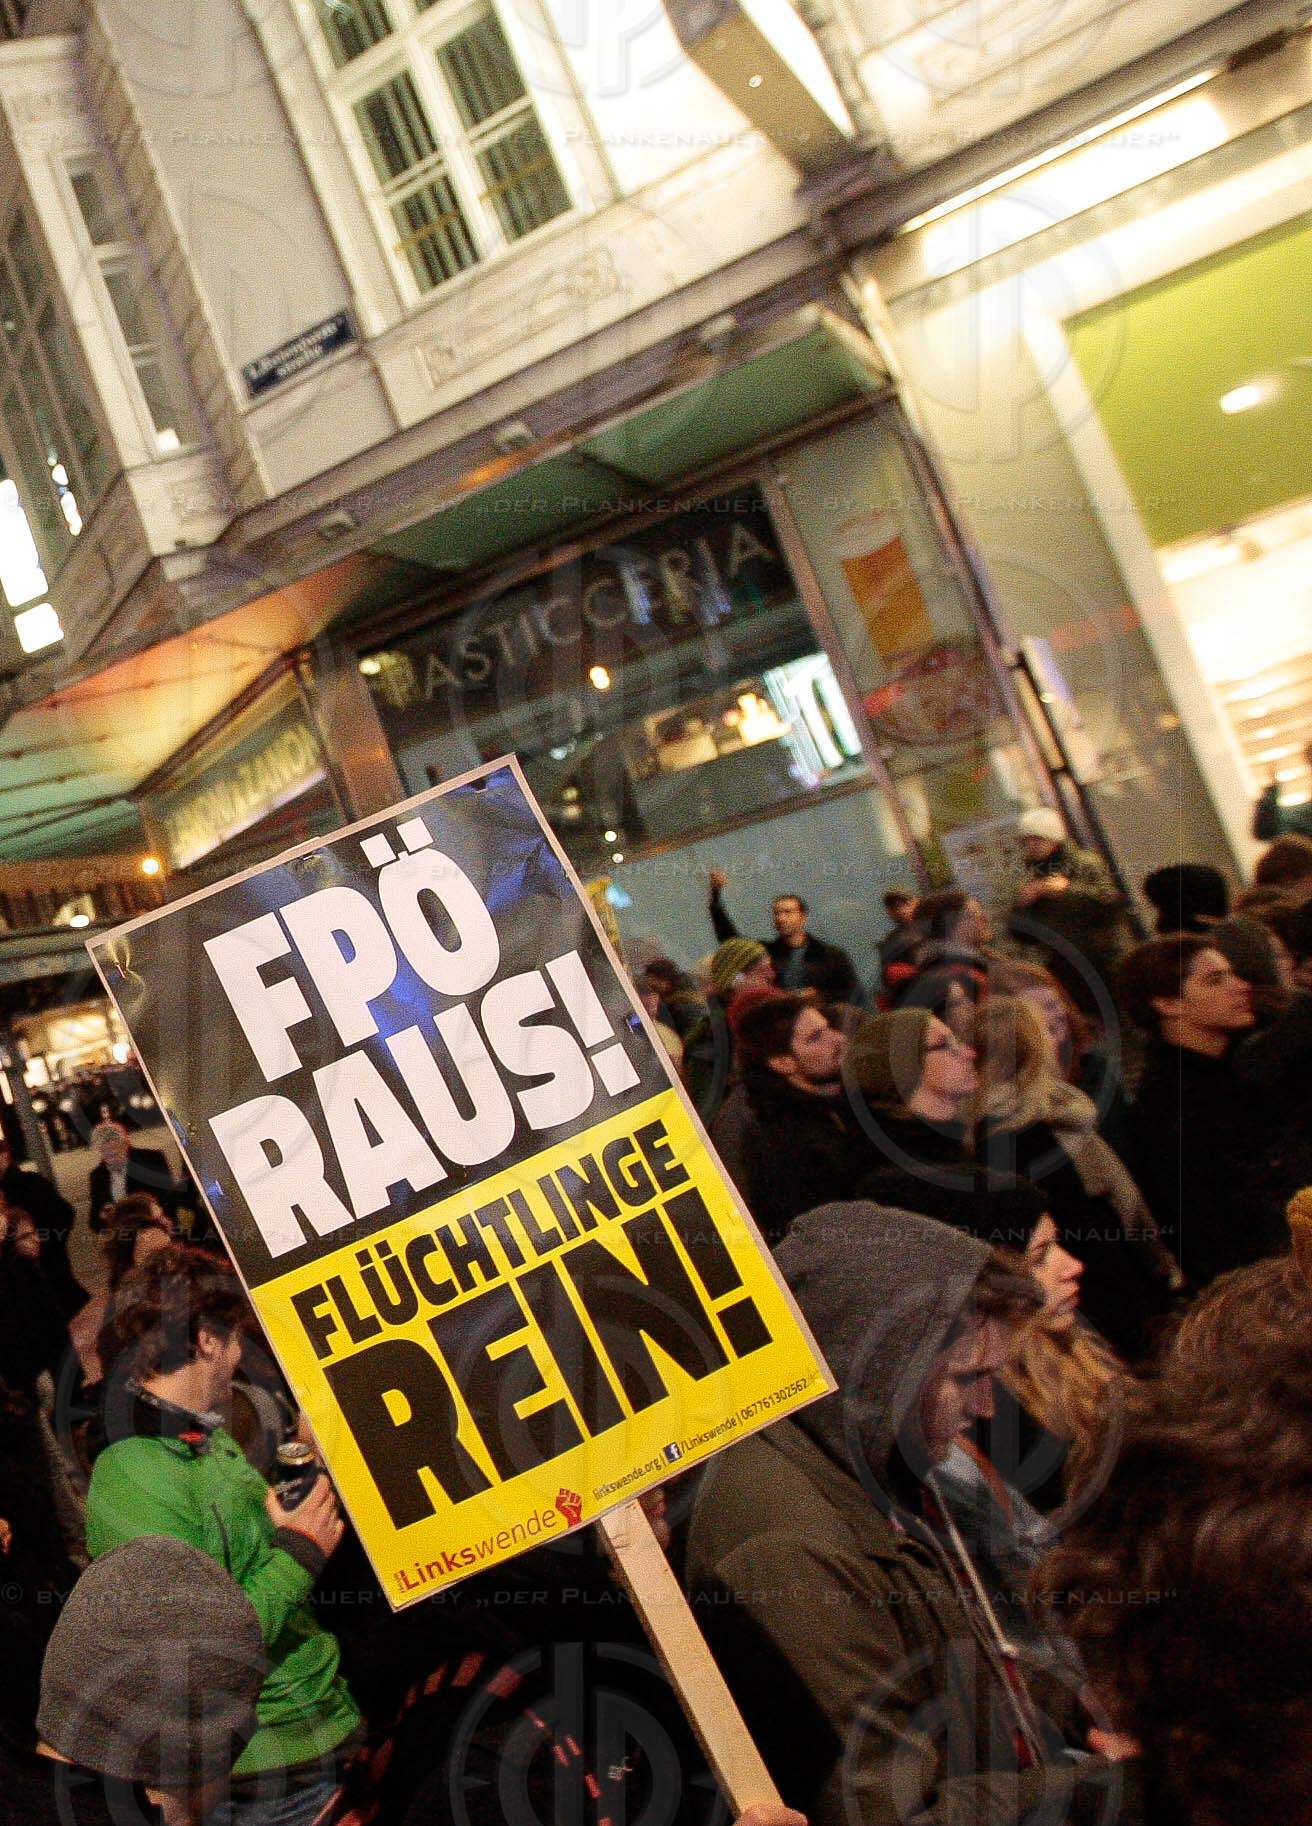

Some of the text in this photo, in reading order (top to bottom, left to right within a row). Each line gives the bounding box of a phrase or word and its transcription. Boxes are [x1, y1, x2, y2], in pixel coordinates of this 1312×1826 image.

[203, 818, 500, 1082] FPÖ
[209, 951, 640, 1258] RAUS!
[291, 1120, 690, 1361] FLÜCHTLINGE
[323, 1186, 773, 1531] REIN!
[399, 1509, 557, 1590] Linkswende
